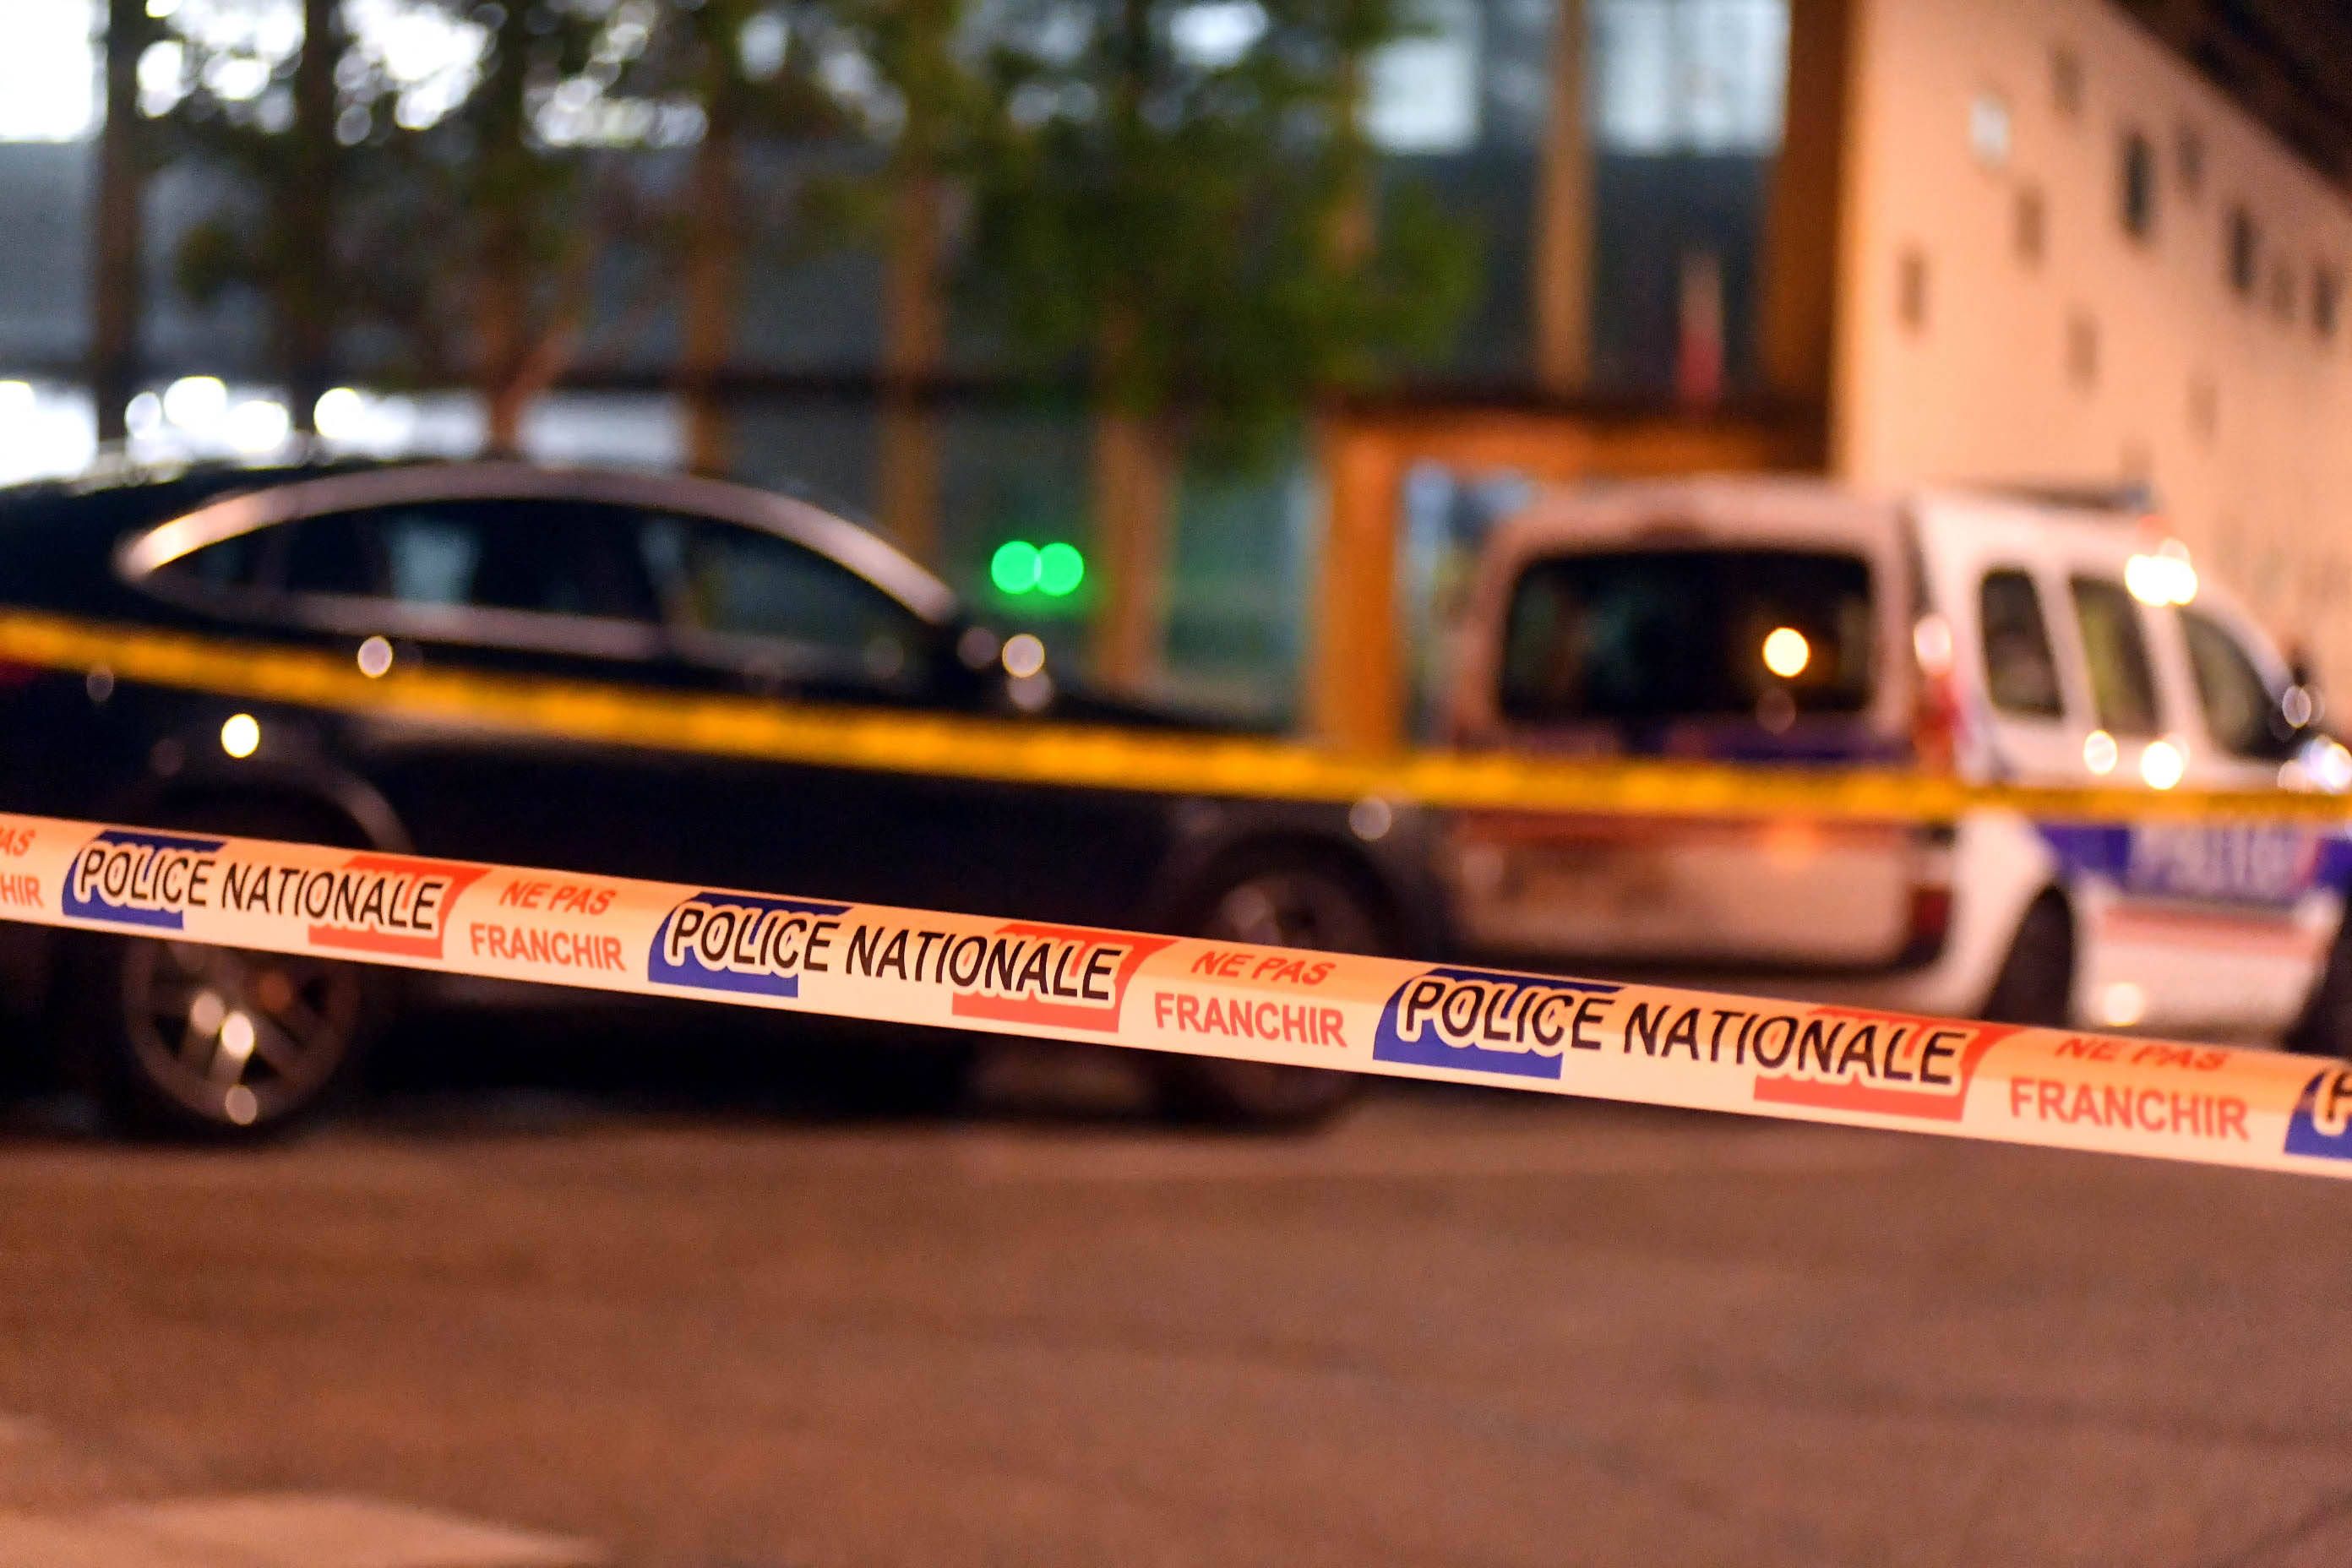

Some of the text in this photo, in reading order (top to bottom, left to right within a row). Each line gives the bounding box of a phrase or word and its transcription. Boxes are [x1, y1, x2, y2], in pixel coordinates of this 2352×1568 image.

[0, 826, 36, 856] AS
[80, 848, 443, 930] POLICE NATIONALE
[499, 879, 618, 916] NE PAS
[470, 923, 627, 971] FRANCHIR
[672, 907, 1122, 1000] POLICE NATIONALE
[1190, 950, 1337, 986] NE PAS
[1154, 992, 1348, 1048] FRANCHIR
[1406, 980, 1967, 1085] POLICE NATIONALE
[2053, 1037, 2233, 1072] NE PAS
[2009, 1075, 2251, 1141] FRANCHIR
